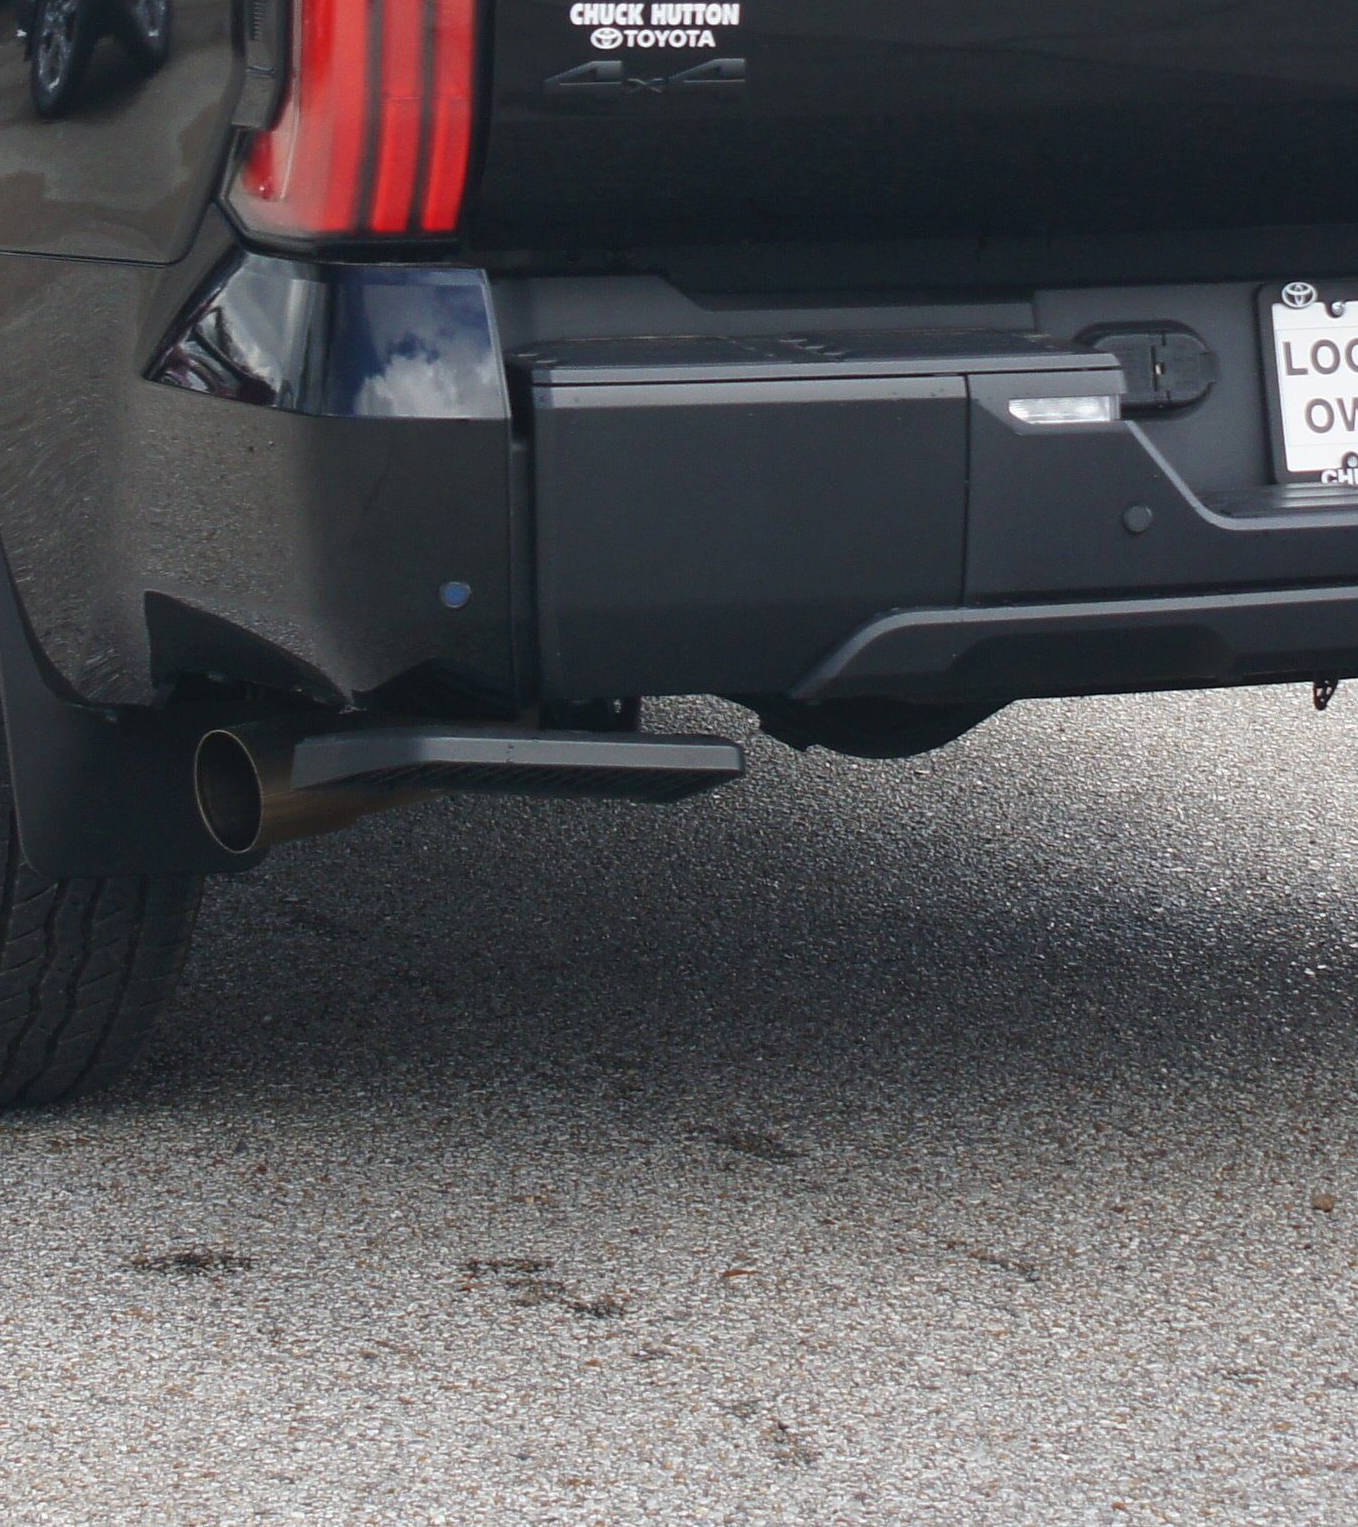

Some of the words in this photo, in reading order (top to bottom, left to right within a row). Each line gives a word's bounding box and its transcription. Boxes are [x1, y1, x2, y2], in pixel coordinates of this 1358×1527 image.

[569, 2, 645, 25] CHUCK
[650, 2, 741, 25] HUTTON
[623, 29, 717, 49] TOYOTA
